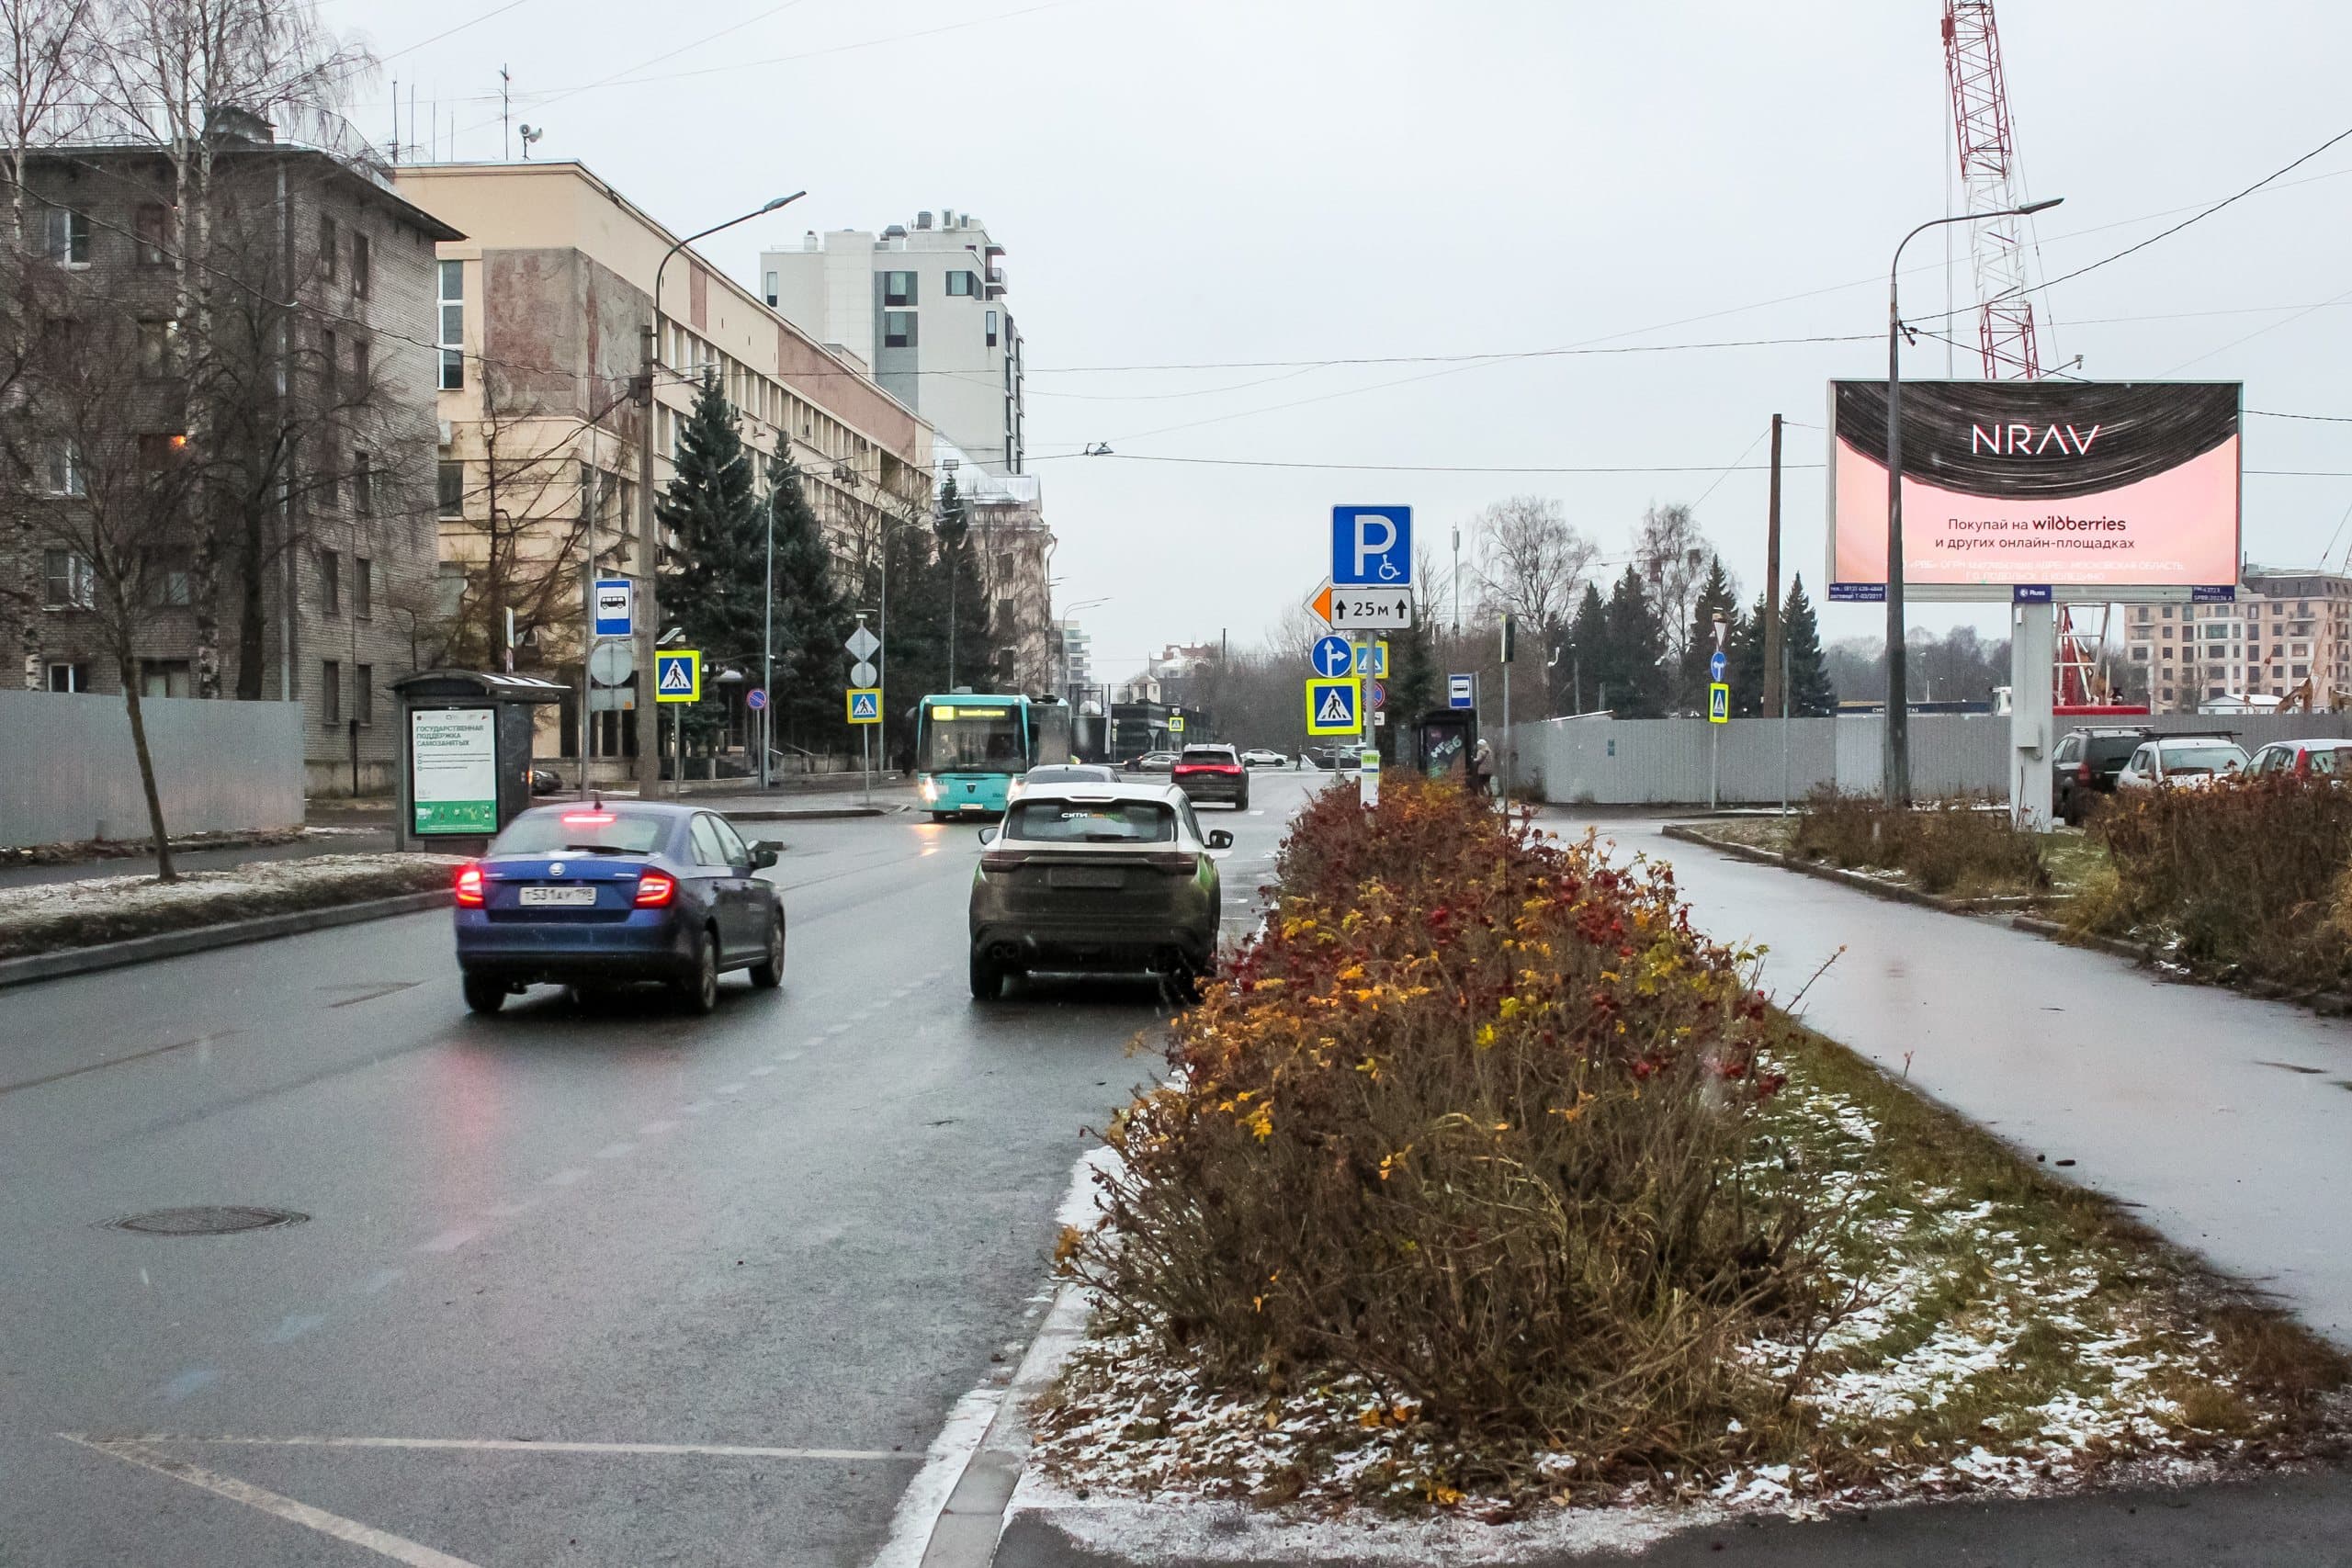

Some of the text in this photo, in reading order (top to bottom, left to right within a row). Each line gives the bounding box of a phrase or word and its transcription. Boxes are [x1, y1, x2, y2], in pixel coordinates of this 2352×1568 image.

[1973, 424, 2100, 456] NRAV
[1948, 515, 2126, 534] Покупай на wildberries
[1354, 514, 1397, 576] P
[1935, 536, 2135, 551] и других онлайн-площадках
